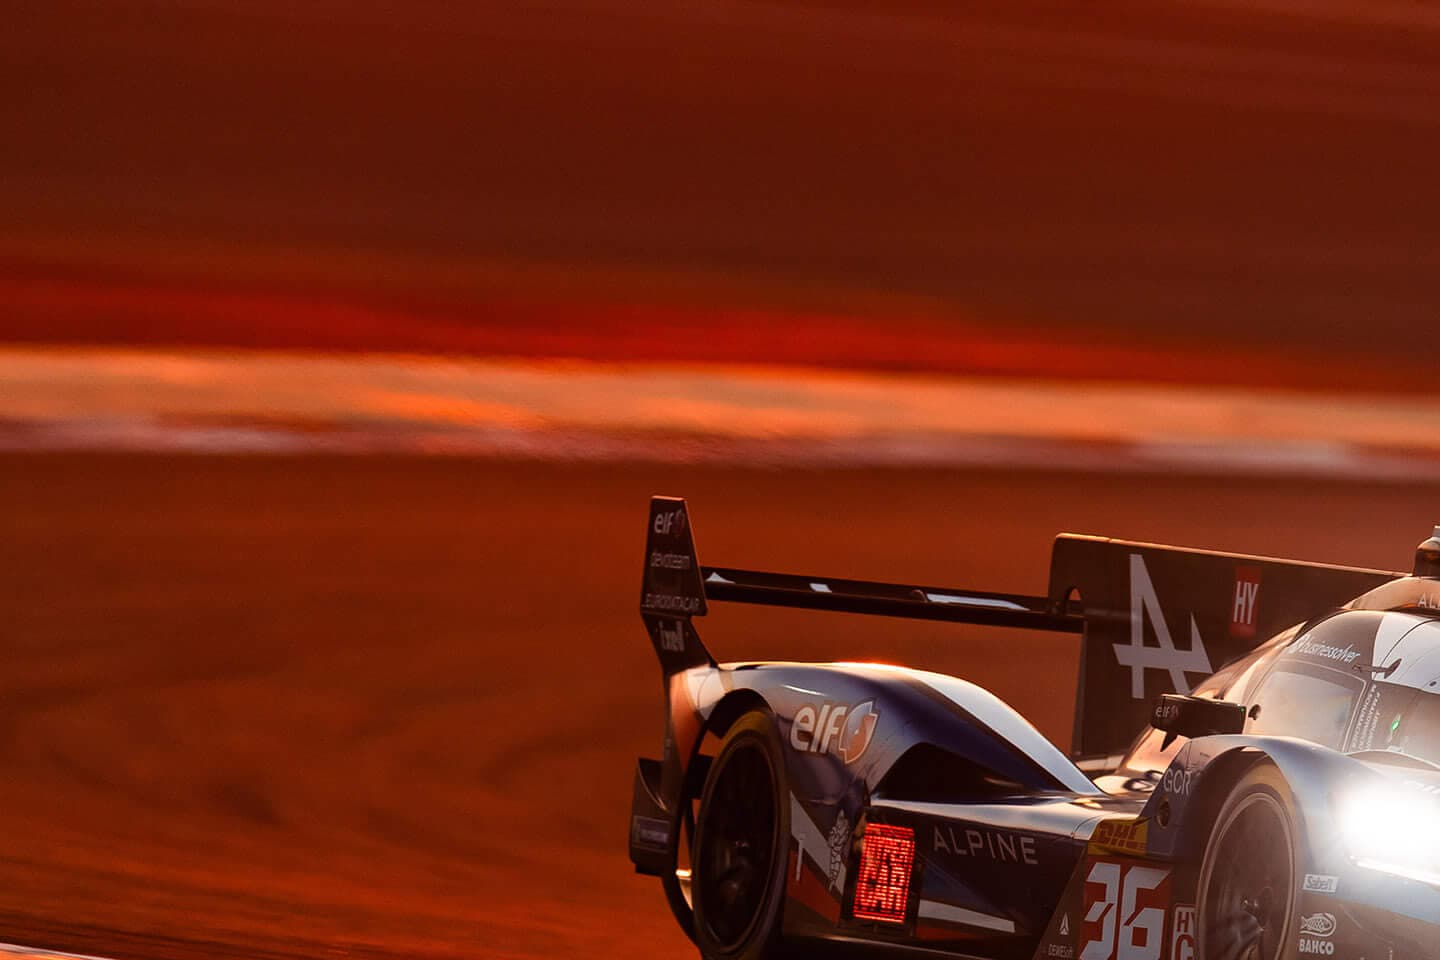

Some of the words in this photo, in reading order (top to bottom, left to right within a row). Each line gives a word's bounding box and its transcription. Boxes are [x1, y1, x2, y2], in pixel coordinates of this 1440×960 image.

[654, 511, 674, 534] elf
[1233, 580, 1259, 625] HY
[1155, 704, 1170, 718] elf
[791, 704, 848, 754] elf
[933, 825, 1039, 865] ALPINE
[1299, 939, 1335, 955] BAHCO
